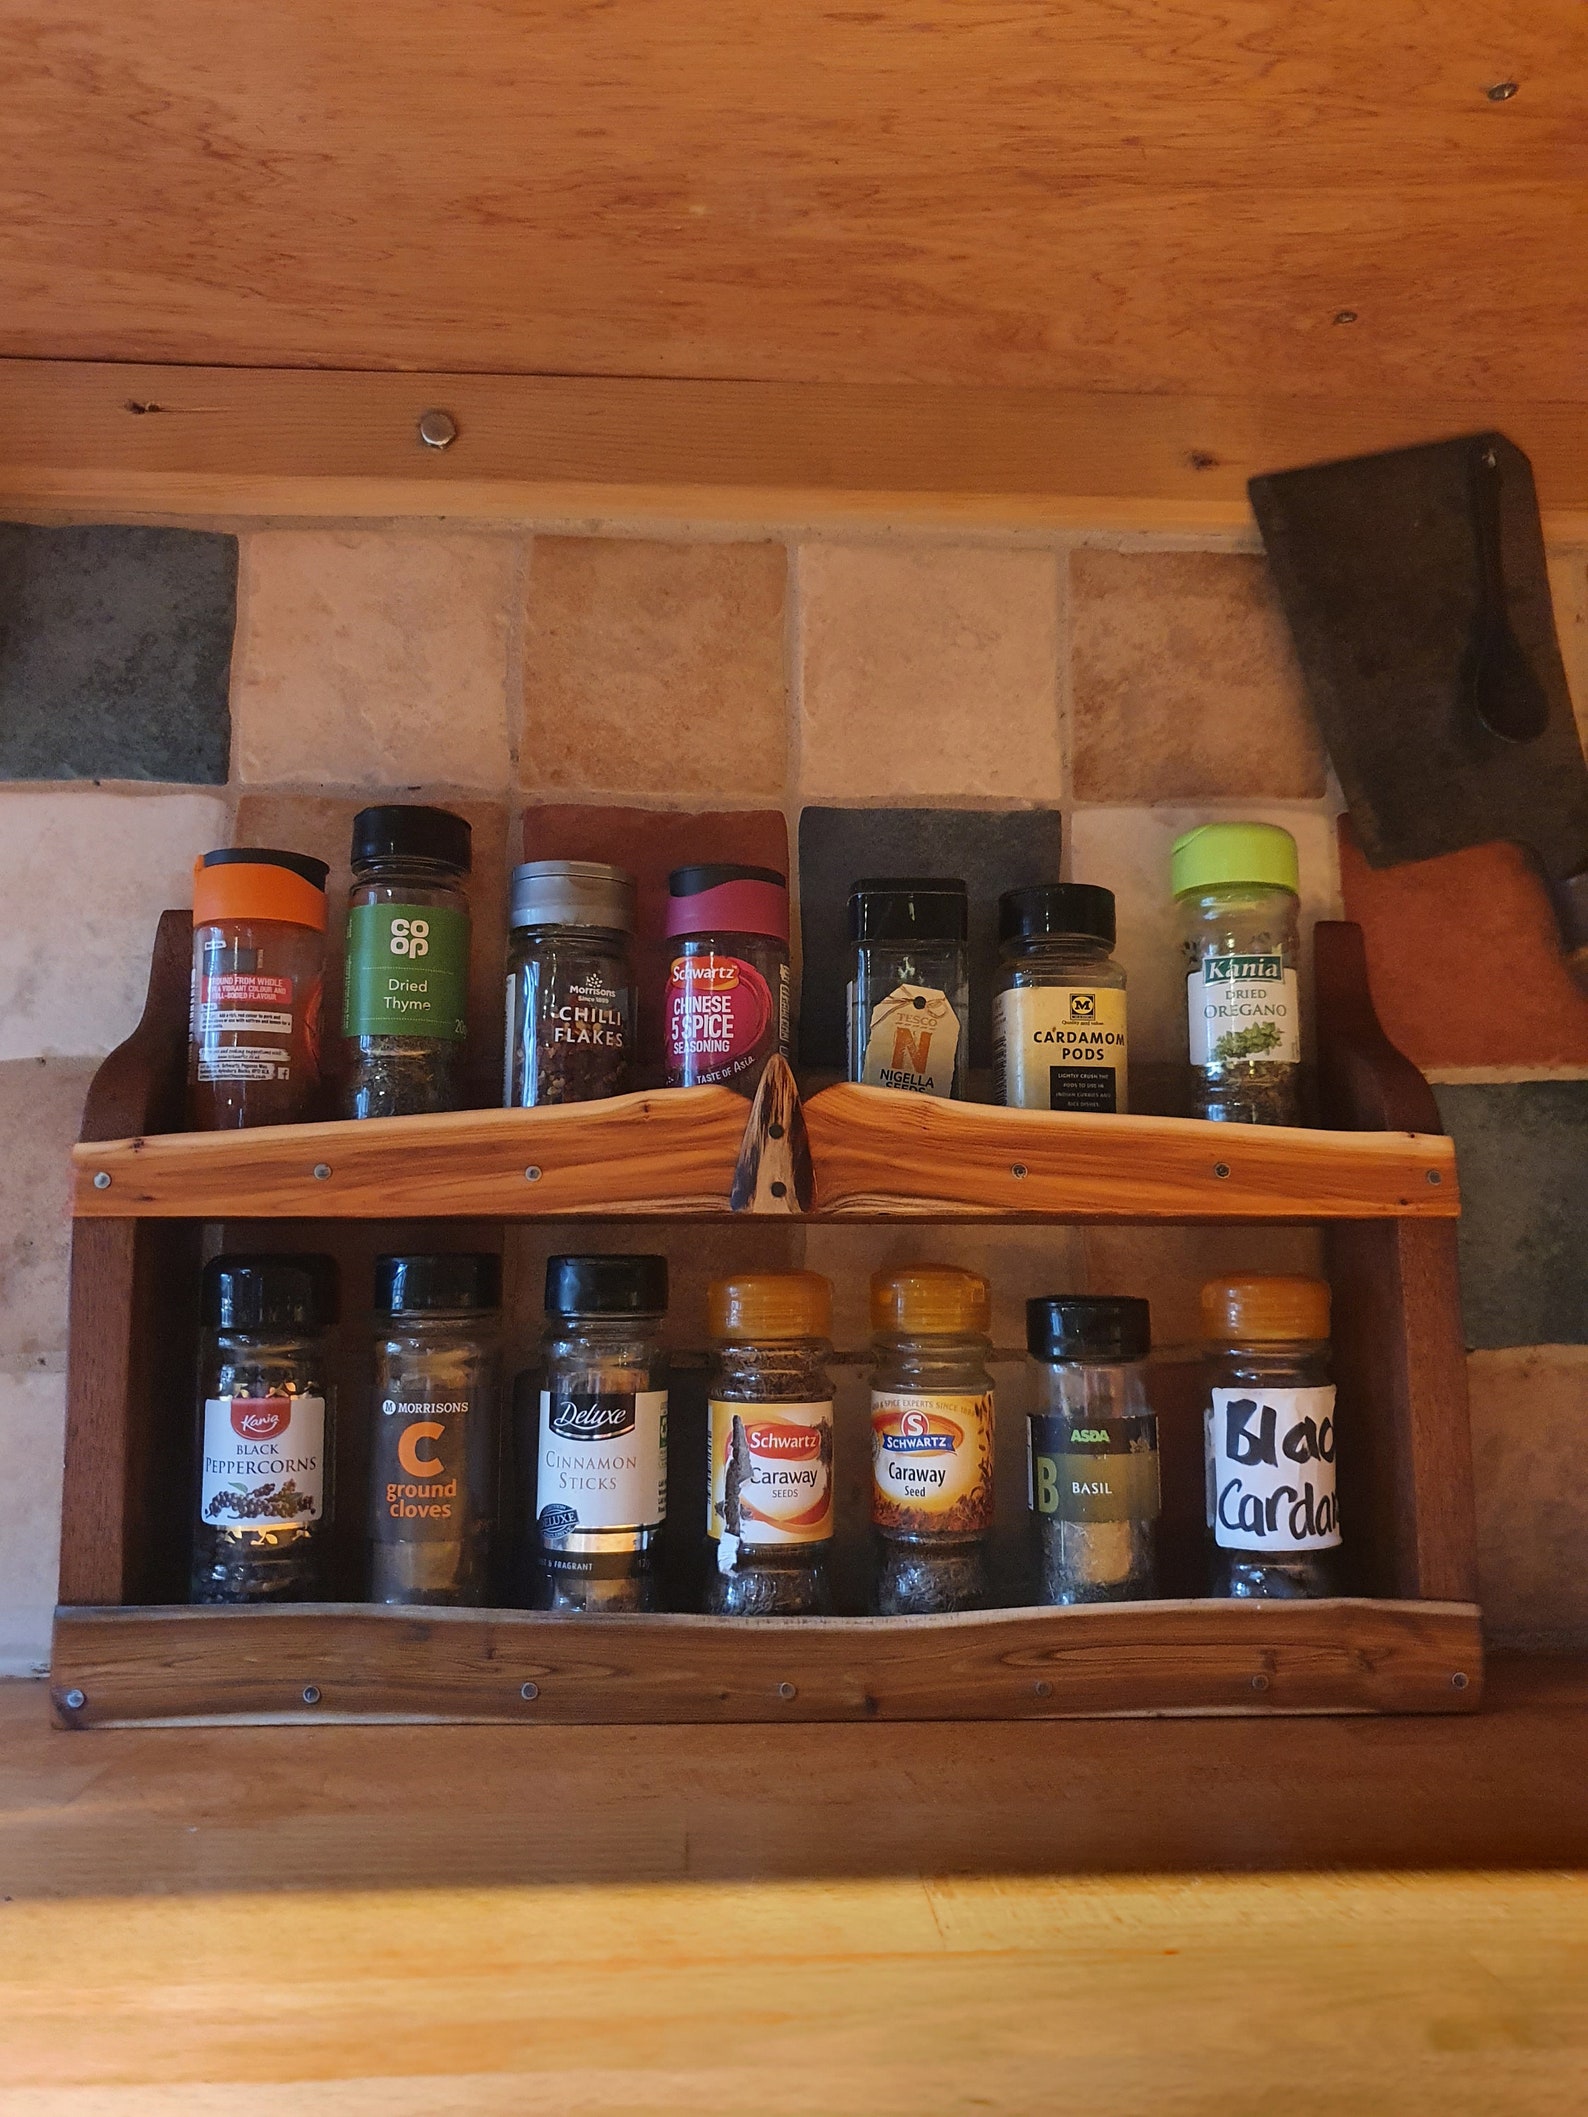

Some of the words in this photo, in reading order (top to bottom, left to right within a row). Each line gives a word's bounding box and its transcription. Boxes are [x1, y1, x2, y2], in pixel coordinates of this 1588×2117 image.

[672, 965, 735, 982] Schwartz
[1209, 958, 1277, 979] Kania
[257, 977, 283, 987] WHOLE
[388, 978, 428, 992] Dried
[569, 985, 616, 998] Morrisons
[1225, 989, 1267, 1000] DRIED
[383, 995, 431, 1013] Thyme
[673, 995, 732, 1016] CHINESE
[1074, 1000, 1090, 1010] M
[1203, 1004, 1287, 1019] OREGANO
[559, 1006, 621, 1026] CHILLI
[897, 1012, 937, 1027] TESCO
[671, 1016, 679, 1040] 5
[681, 1014, 734, 1039] SPICE
[554, 1027, 623, 1047] FLAKES
[1033, 1031, 1125, 1046] CARDAMOM
[673, 1040, 730, 1054] SEASONING
[891, 1027, 933, 1074] N
[1062, 1048, 1104, 1060] PODS
[697, 1072, 720, 1084] TASTE
[722, 1067, 732, 1077] OF
[733, 1055, 755, 1073] Asia
[880, 1068, 934, 1088] NIGELLA
[397, 1402, 469, 1414] MORRISONS
[902, 1400, 933, 1408] EXPERTS
[241, 1414, 280, 1433] Kania
[553, 1401, 626, 1430] Deluxe
[906, 1414, 923, 1436] S
[750, 1432, 817, 1448] Schwartz
[886, 1436, 946, 1449] SCHWARTZ
[1070, 1429, 1110, 1443] ASDA
[236, 1444, 279, 1455] BLACK
[398, 1421, 446, 1478] C
[205, 1456, 317, 1475] PEPPERCORNS
[546, 1450, 637, 1470] CINNAMON
[559, 1471, 617, 1490] STICKS
[750, 1467, 818, 1487] Caraway
[888, 1462, 946, 1487] Caraway
[386, 1478, 457, 1502] ground
[772, 1489, 799, 1498] SEEDS
[904, 1485, 926, 1497] Seed
[1037, 1456, 1059, 1514] B
[1072, 1481, 1112, 1494] BASIL
[389, 1499, 452, 1518] cloves
[1218, 1477, 1337, 1540] Carda
[554, 1560, 593, 1571] FRAGRANT
